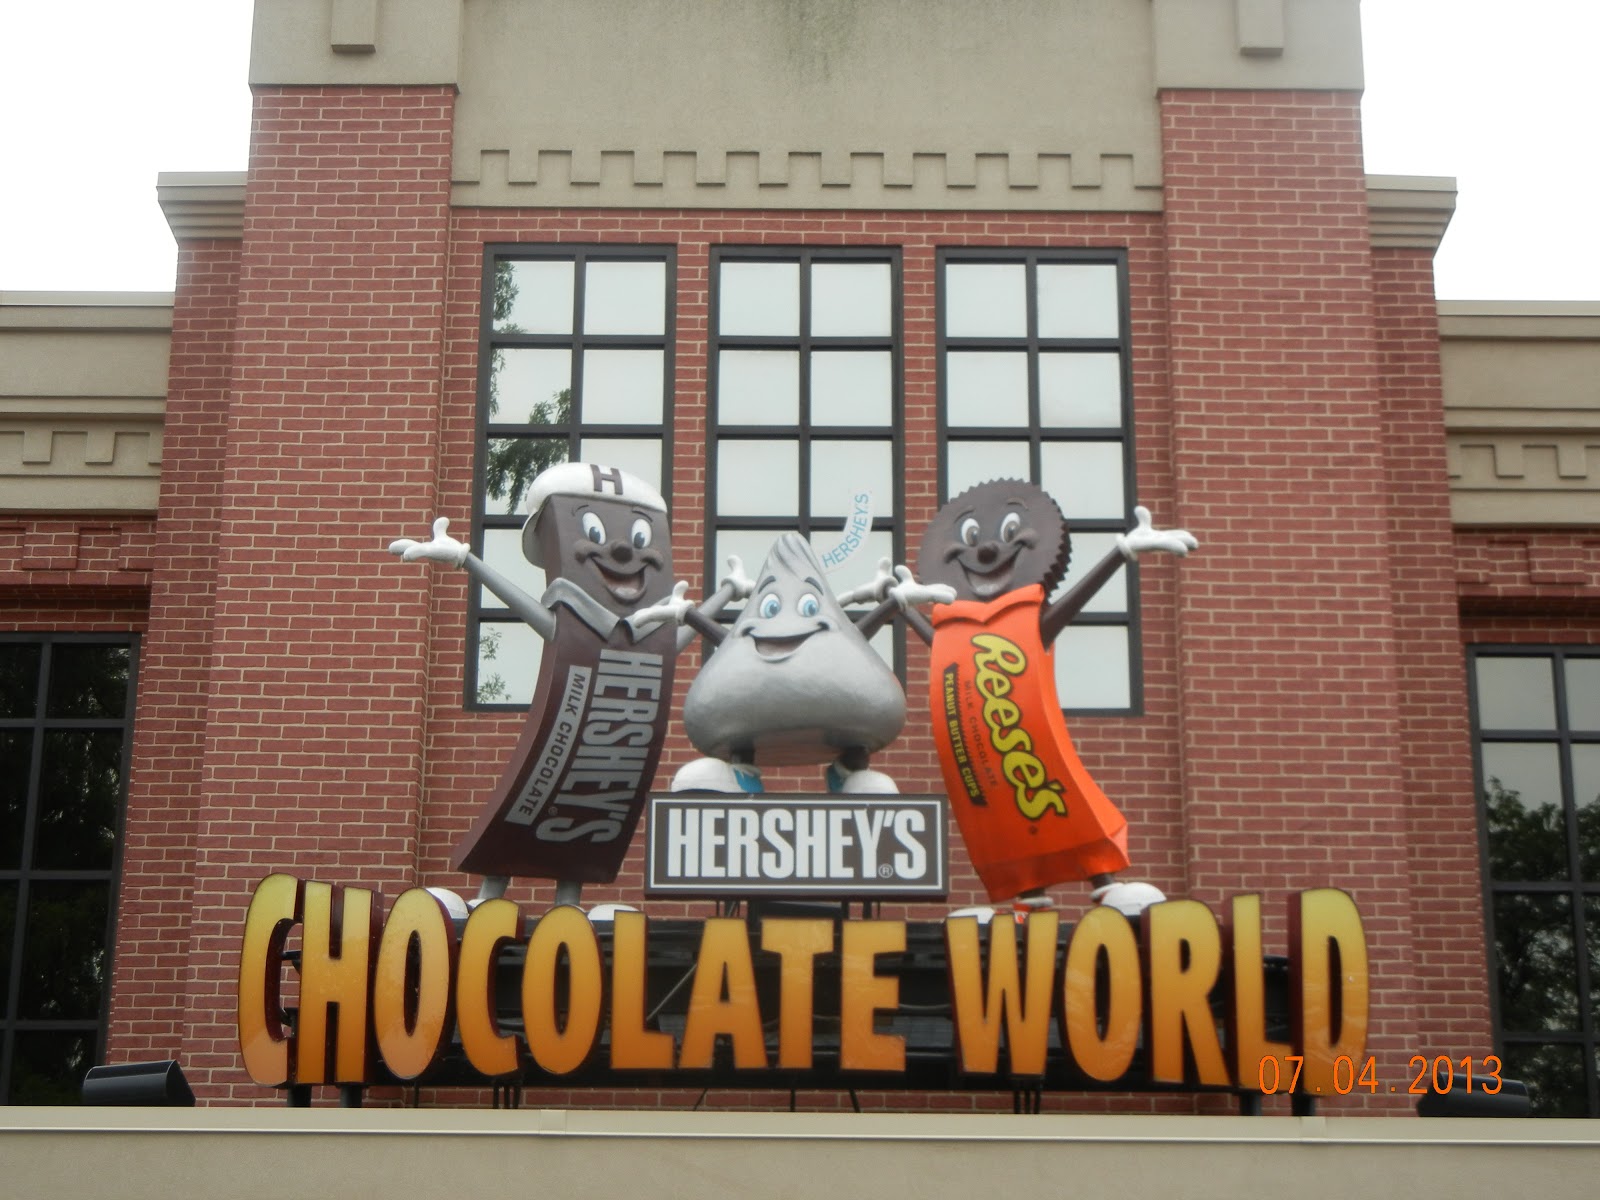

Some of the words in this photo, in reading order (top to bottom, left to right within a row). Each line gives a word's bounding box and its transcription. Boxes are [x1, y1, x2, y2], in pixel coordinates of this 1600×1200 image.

[590, 464, 623, 495] H
[565, 673, 586, 716] MILK
[946, 673, 955, 715] PEANUT
[535, 649, 663, 843] HERSHEY'S
[949, 721, 965, 765] BUTTER
[970, 633, 1068, 820] Reese's
[519, 721, 573, 816] CHOCOLATE
[962, 767, 980, 798] CUPS
[667, 808, 927, 879] HERSHEY'S
[238, 872, 907, 1085] CHOCOLATE
[945, 887, 1369, 1096] WORLD
